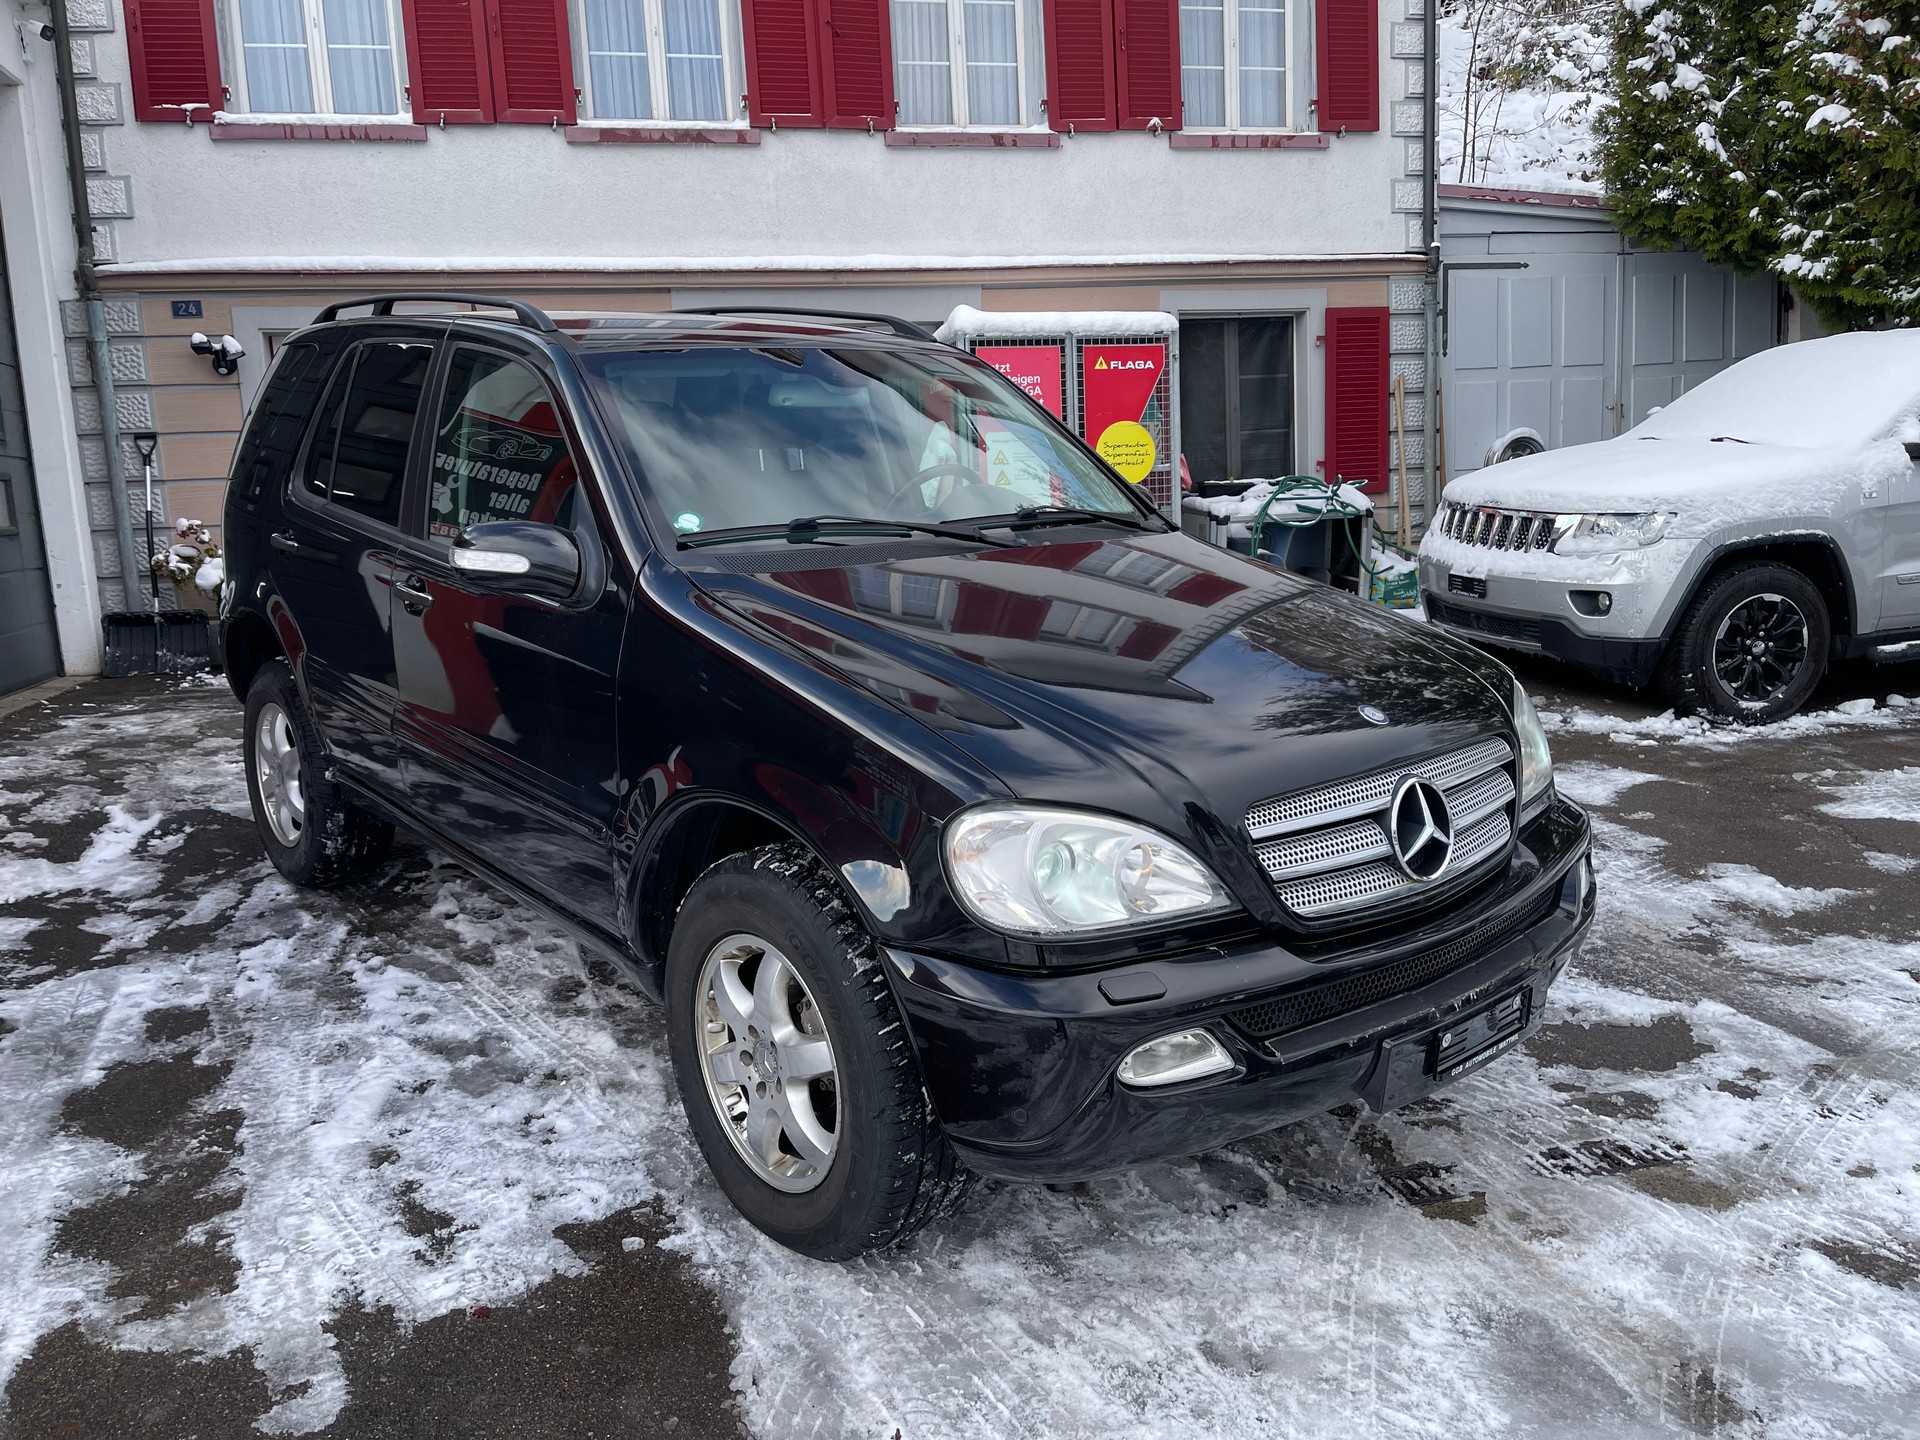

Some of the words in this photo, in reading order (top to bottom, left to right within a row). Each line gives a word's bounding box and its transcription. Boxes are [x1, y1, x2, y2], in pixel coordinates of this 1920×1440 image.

[178, 303, 197, 315] 24
[1111, 361, 1154, 369] FLAGA
[1104, 442, 1149, 451] Supersauber
[1465, 1046, 1497, 1069] AUTOMOBILE
